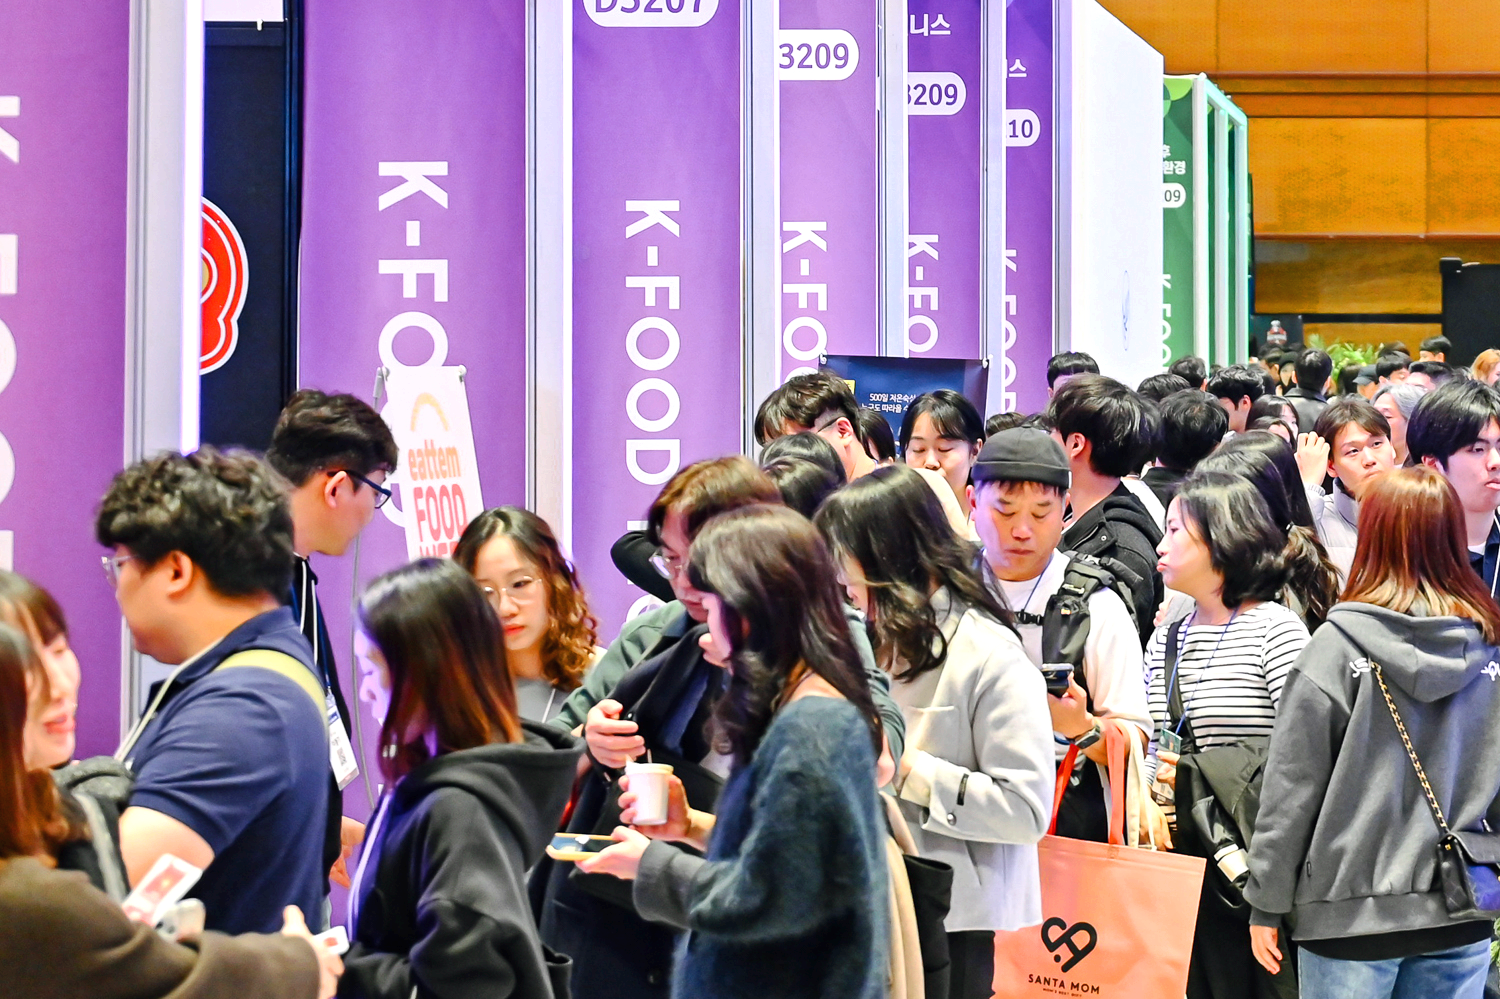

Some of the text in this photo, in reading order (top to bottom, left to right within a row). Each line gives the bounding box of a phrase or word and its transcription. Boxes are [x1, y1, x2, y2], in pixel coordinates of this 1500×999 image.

[908, 13, 952, 36] 니스
[779, 42, 850, 70] 3209
[1007, 58, 1028, 79] 스
[1006, 119, 1033, 138] 10
[625, 199, 681, 486] K-FOOD
[407, 439, 461, 481] eattem
[413, 483, 468, 543] FOOD
[1028, 974, 1099, 994] SANTA MOM
